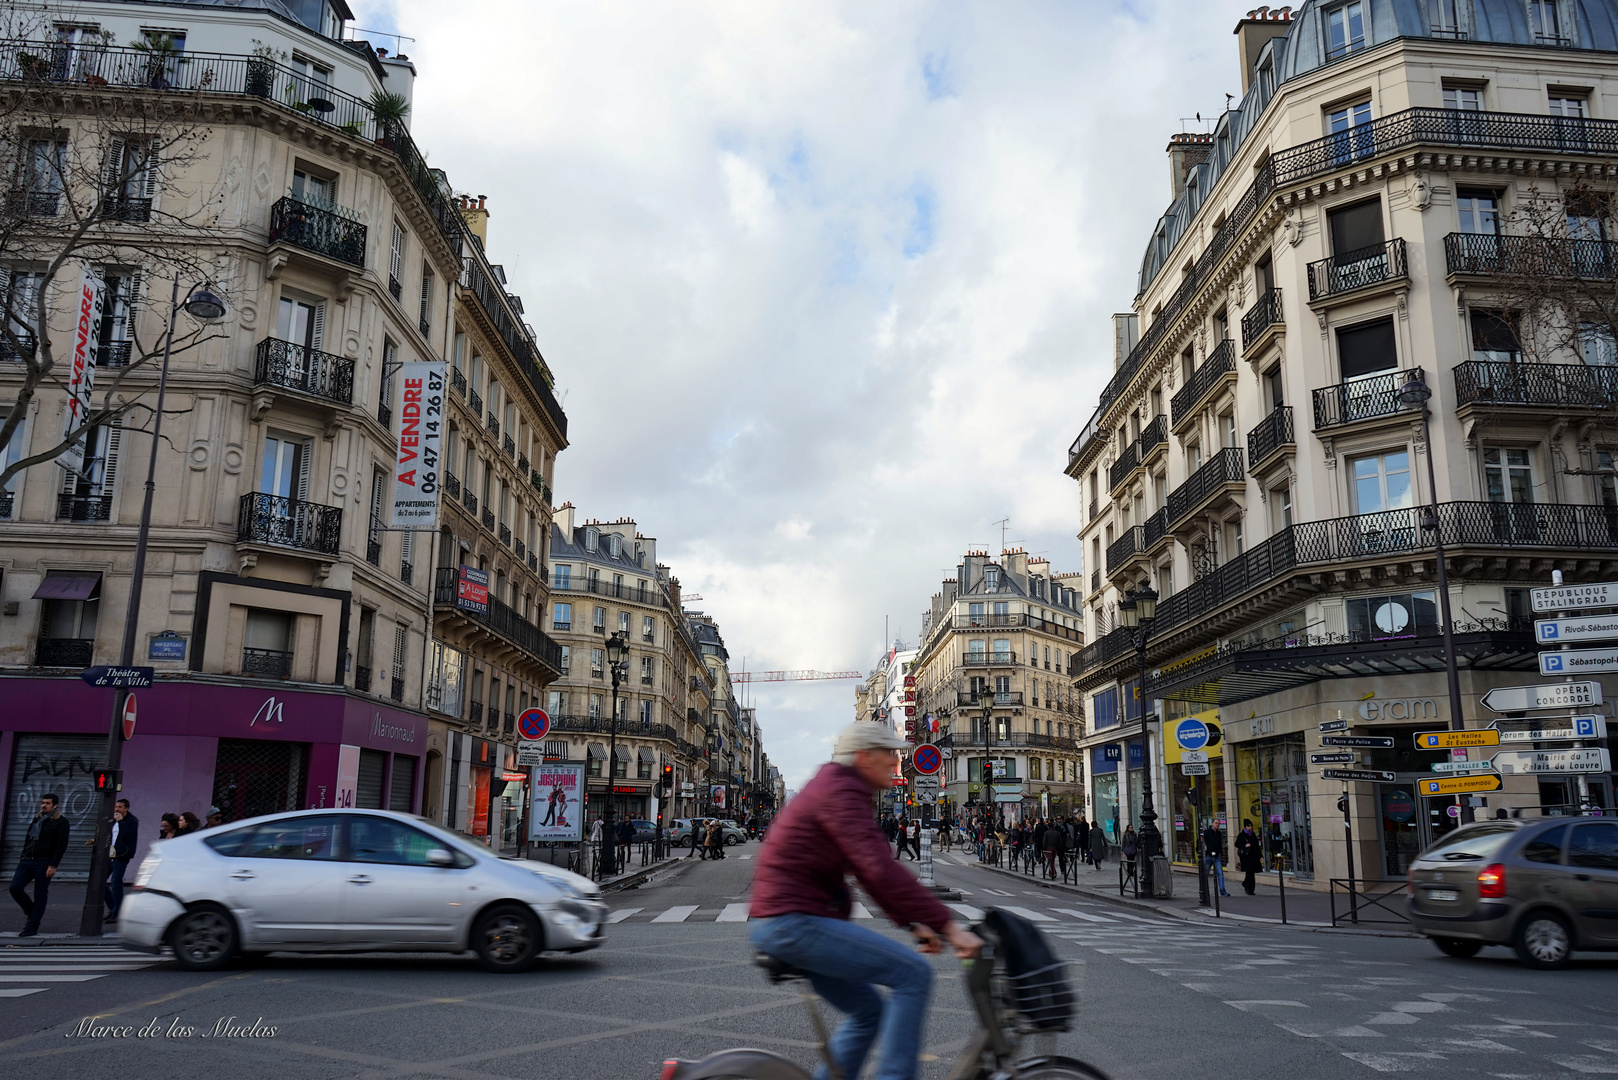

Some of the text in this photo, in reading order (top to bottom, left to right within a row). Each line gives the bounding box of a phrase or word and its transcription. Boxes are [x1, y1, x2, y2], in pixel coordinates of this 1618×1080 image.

[71, 283, 94, 386] VENDRE
[91, 318, 101, 342] 26
[87, 348, 97, 370] 14
[84, 376, 93, 399] 47
[69, 397, 79, 418] A
[397, 378, 423, 487] A VENDRE
[421, 370, 443, 494] 06 47 14 26 87
[394, 500, 436, 508] APPARTEMENTS
[397, 509, 404, 517] du
[404, 509, 409, 517] 2
[408, 509, 415, 517] au
[414, 509, 418, 517] 6
[471, 584, 487, 596] Louer
[1536, 586, 1608, 599] RÉPUBLIQUE
[1537, 596, 1607, 608] STALINGRAD
[1544, 625, 1555, 638] P
[1547, 657, 1559, 670] P
[106, 668, 140, 677] Théâtre
[95, 677, 150, 686] de la Ville
[1536, 694, 1590, 706] CONCORDE
[250, 696, 284, 727] M
[369, 711, 415, 743] Marionnaud
[1528, 730, 1542, 738] des
[1545, 729, 1572, 737] Halles
[1580, 721, 1590, 734] P
[1107, 748, 1119, 757] GAP
[1536, 752, 1566, 761] Mairie
[1522, 760, 1600, 771] Palais du Louvre
